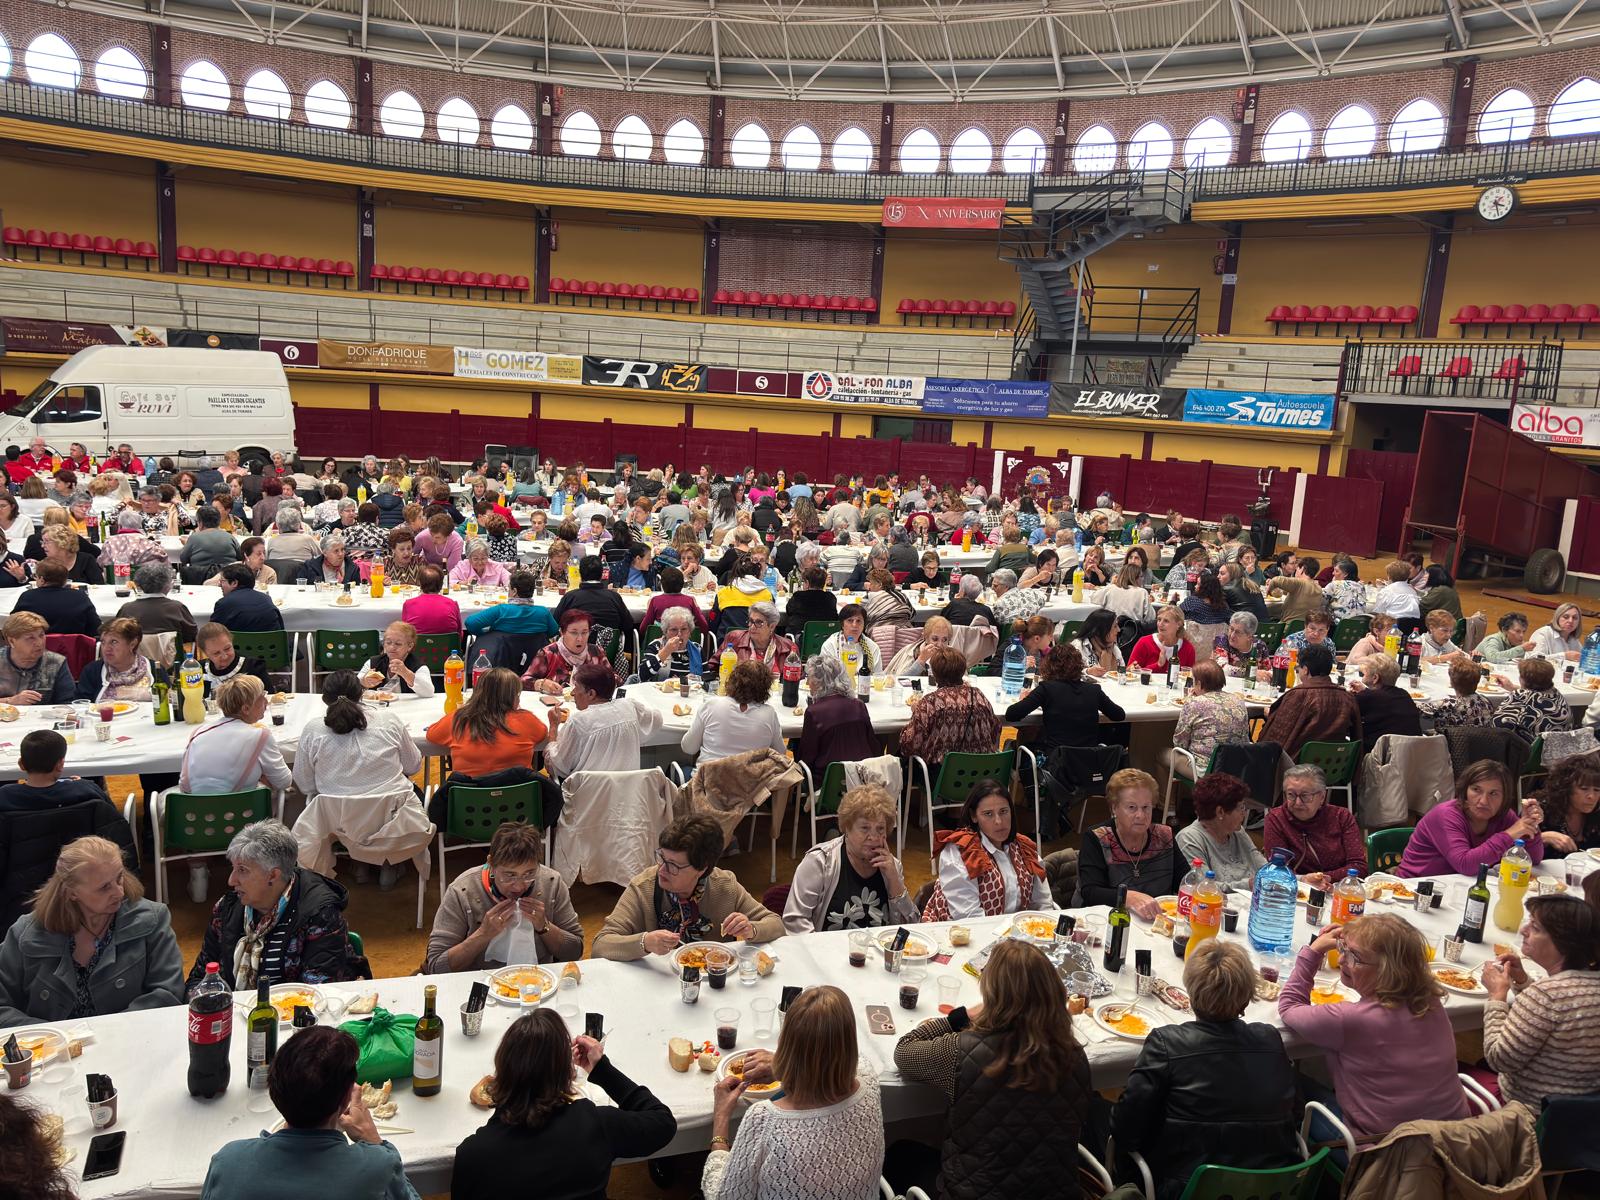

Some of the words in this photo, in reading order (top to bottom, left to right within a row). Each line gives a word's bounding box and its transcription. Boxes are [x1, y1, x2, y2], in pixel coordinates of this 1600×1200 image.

[161, 41, 168, 50] 3
[364, 73, 370, 82] 3
[1463, 77, 1471, 88] 2
[545, 96, 550, 104] 3
[1248, 99, 1256, 109] 2
[716, 109, 722, 118] 3
[1060, 112, 1065, 122] 3
[884, 115, 890, 124] 3
[164, 187, 171, 197] 6
[364, 210, 370, 219] 6
[917, 205, 930, 220] X
[936, 208, 1002, 220] ANIVERSARIO
[542, 226, 548, 236] 6
[710, 238, 716, 248] 5
[876, 246, 882, 255] 5
[1438, 244, 1446, 254] 4
[287, 346, 295, 358] 6
[348, 346, 427, 358] DONFADRIQUE
[486, 352, 544, 372] GOMEZ
[458, 368, 492, 377] MATERIALES
[886, 379, 912, 390] ALBA
[1074, 390, 1096, 408] EL
[1094, 388, 1160, 415] BUNKER
[1276, 398, 1325, 410] Autoescuela
[1256, 402, 1324, 426] Tormes
[1518, 406, 1584, 436] alba
